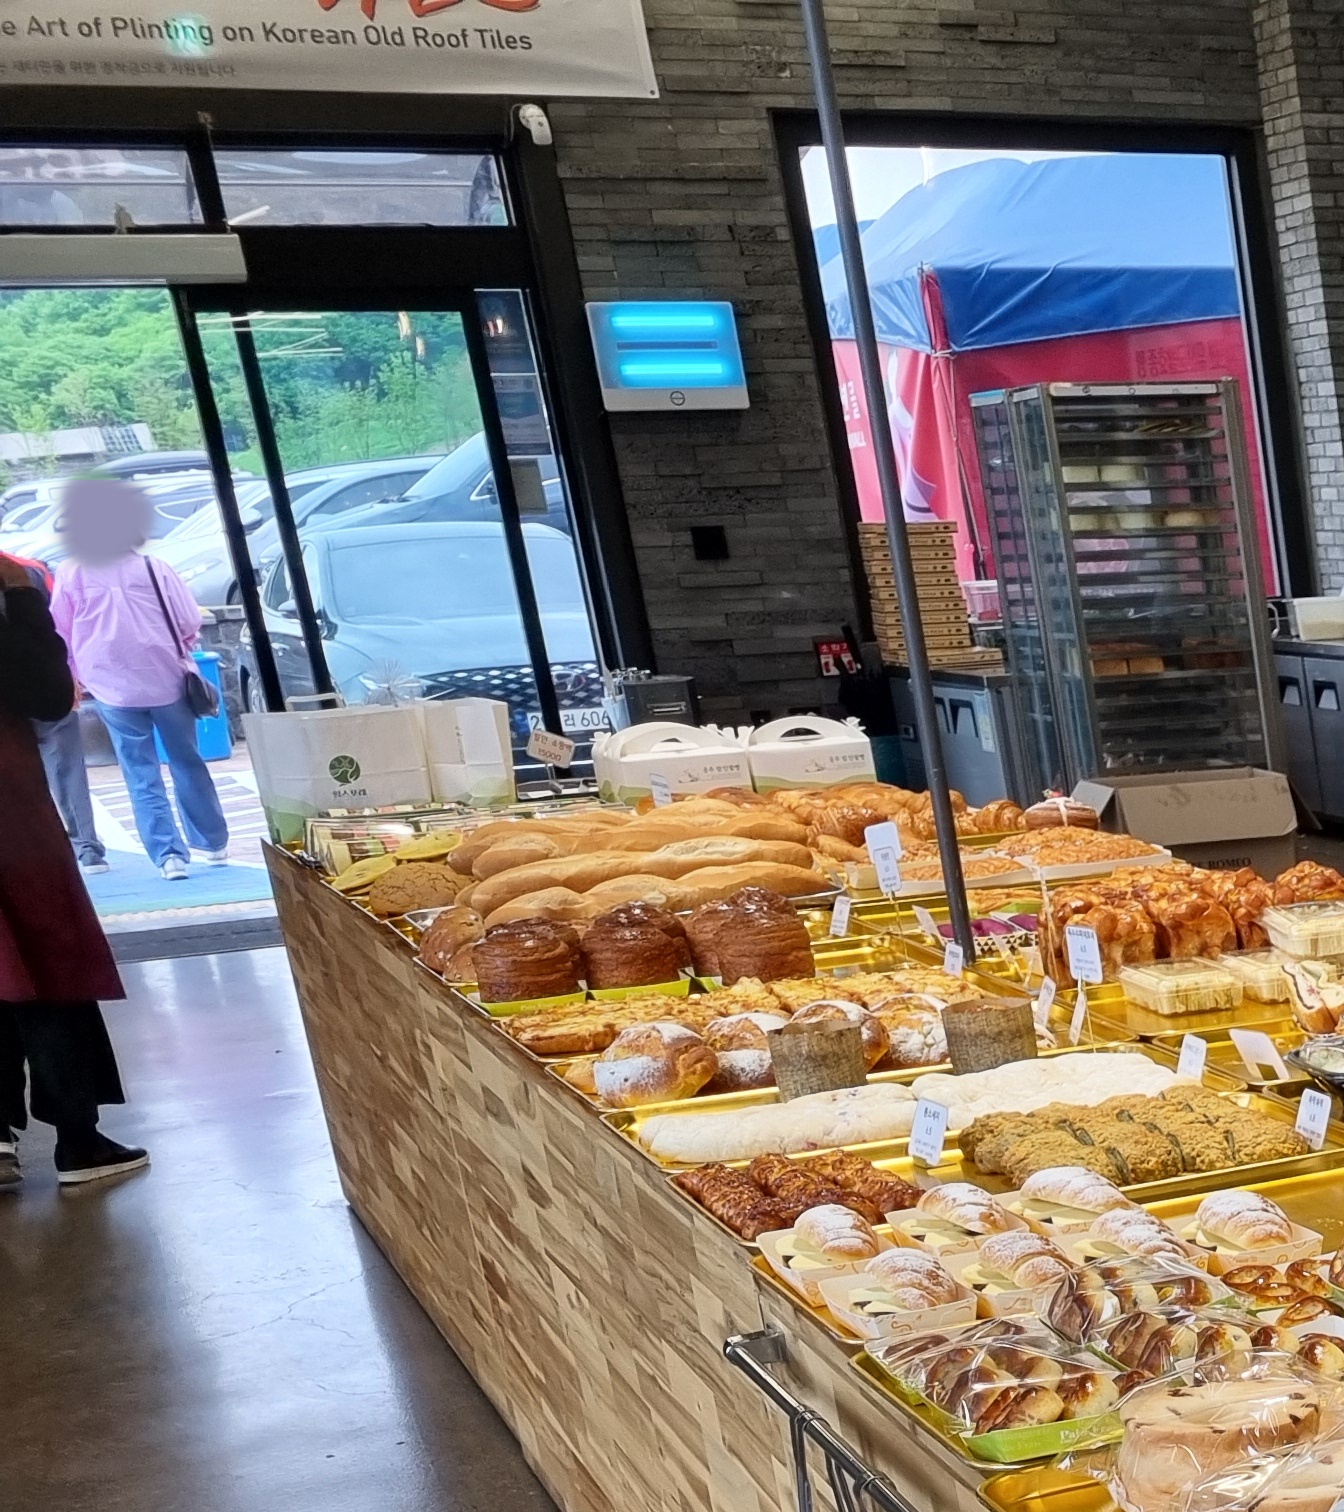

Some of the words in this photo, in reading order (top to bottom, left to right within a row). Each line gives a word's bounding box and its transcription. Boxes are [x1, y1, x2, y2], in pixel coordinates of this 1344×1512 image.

[26, 15, 70, 38] Art
[77, 16, 104, 39] of
[110, 16, 215, 47] Plinting
[221, 24, 255, 43] on
[261, 21, 357, 46] Korean
[364, 24, 406, 48] Old
[412, 26, 470, 50] Roof
[474, 27, 533, 51] Tiles
[538, 747, 562, 762] 15000
